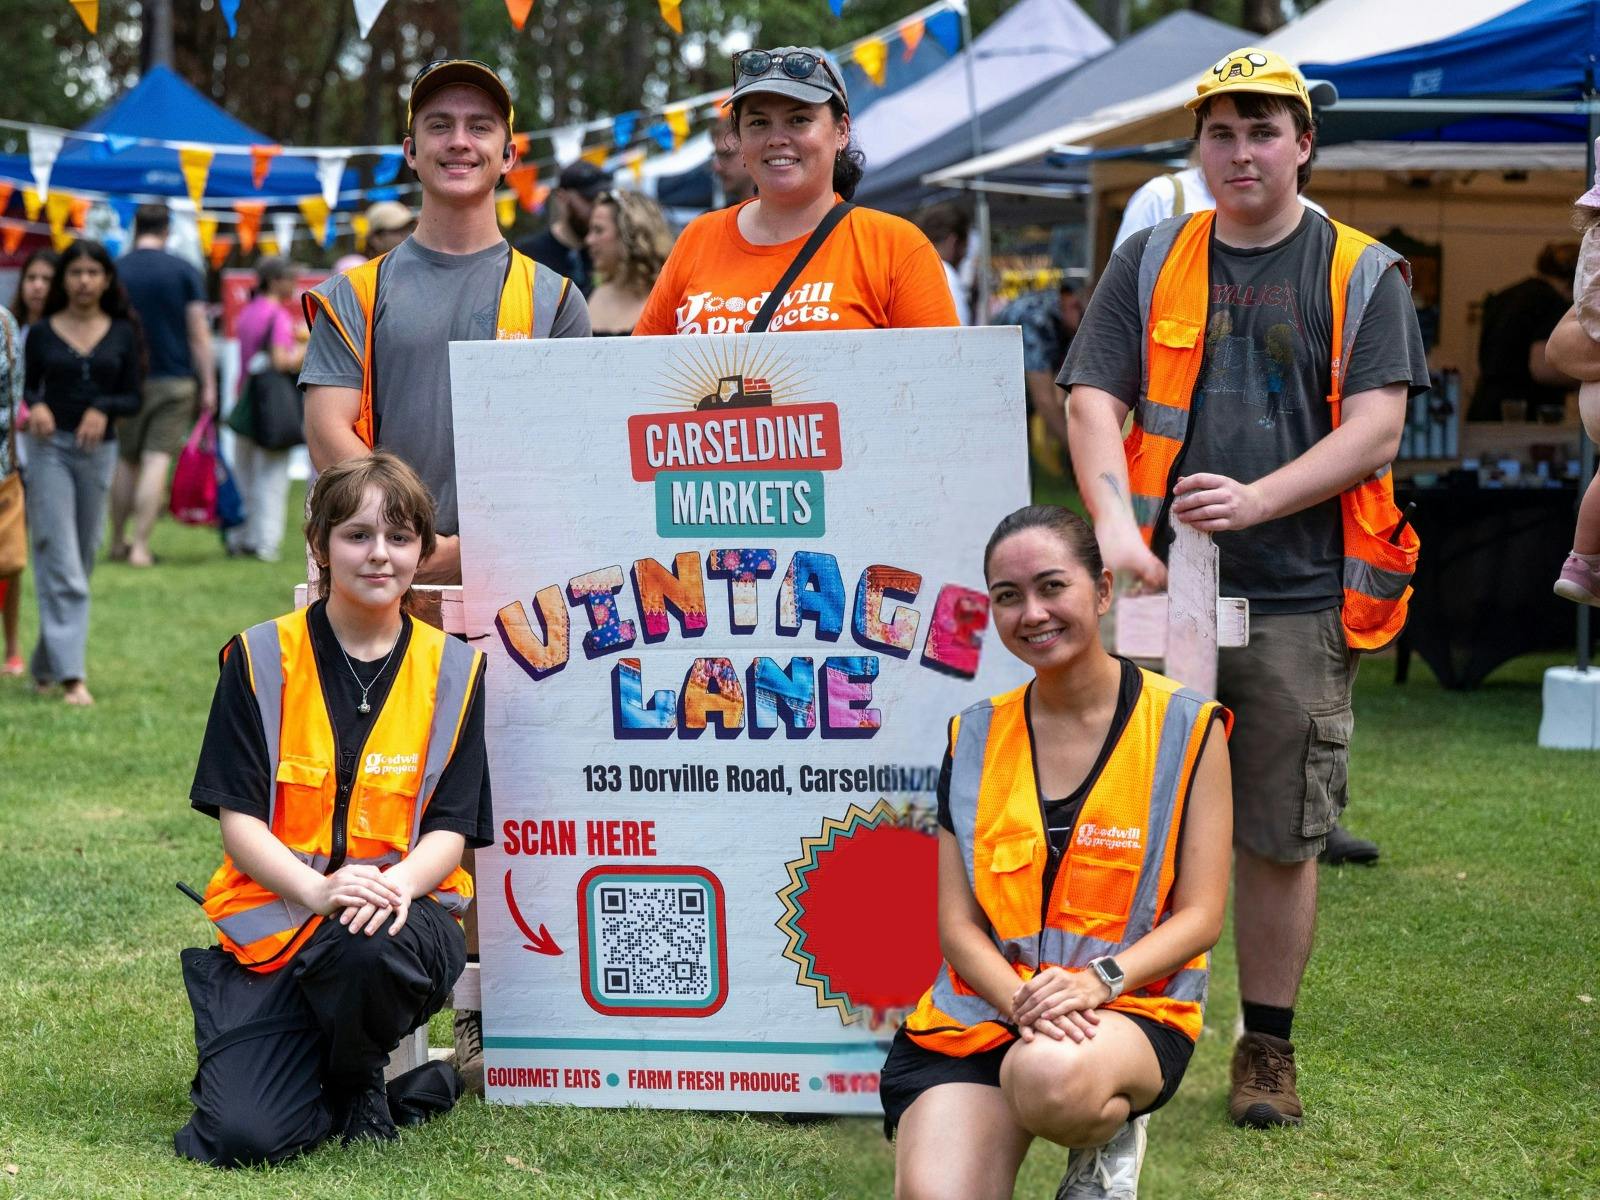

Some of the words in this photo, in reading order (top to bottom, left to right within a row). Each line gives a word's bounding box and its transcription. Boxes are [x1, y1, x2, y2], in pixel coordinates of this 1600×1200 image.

[645, 413, 827, 468] CARSELDINE
[671, 480, 812, 526] MARKETS
[495, 548, 988, 682] VINTAGE
[612, 655, 881, 740] LANE
[582, 764, 622, 793] 133
[629, 764, 719, 793] Dorville
[726, 764, 793, 795] Road,
[502, 820, 577, 856] SCAN
[586, 820, 657, 856] HERE
[487, 1067, 560, 1089] GOURMET
[564, 1068, 601, 1090] EATS
[628, 1069, 673, 1090] FARM
[676, 1069, 725, 1092] FRESH
[729, 1071, 800, 1093] PRODUCE
